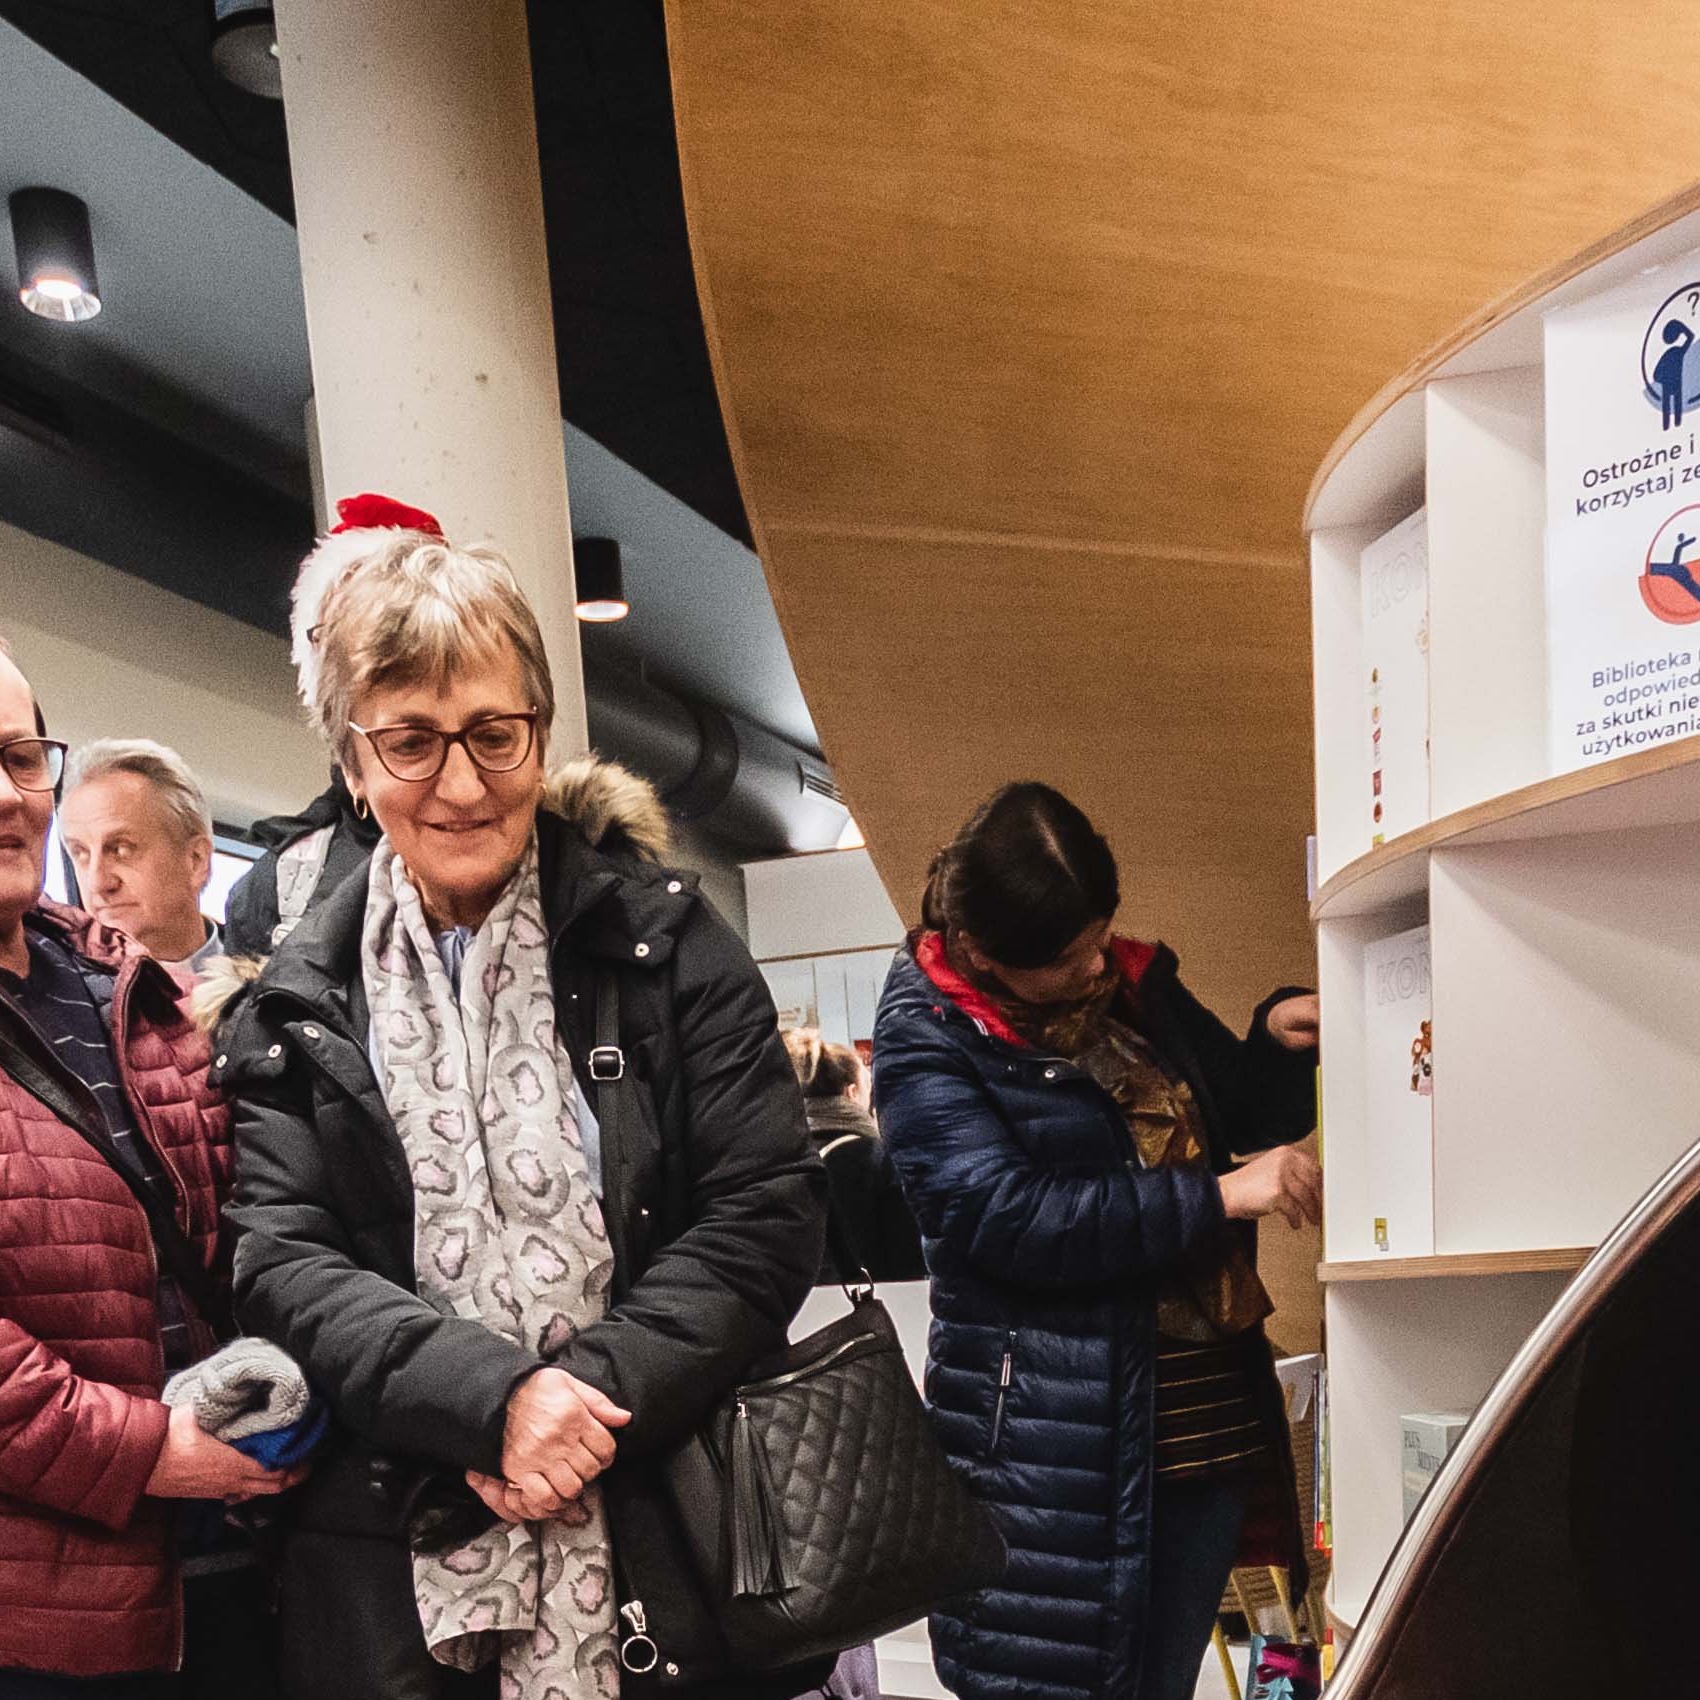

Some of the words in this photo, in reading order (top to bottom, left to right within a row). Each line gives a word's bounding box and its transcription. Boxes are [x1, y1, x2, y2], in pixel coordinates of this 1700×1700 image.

[1583, 444, 1682, 488] Ostrożne
[1690, 433, 1695, 454] i
[1576, 467, 1674, 516] korzystaj
[1592, 652, 1691, 688] Biblioteka
[1576, 719, 1596, 736] za
[1602, 699, 1662, 730] skutki
